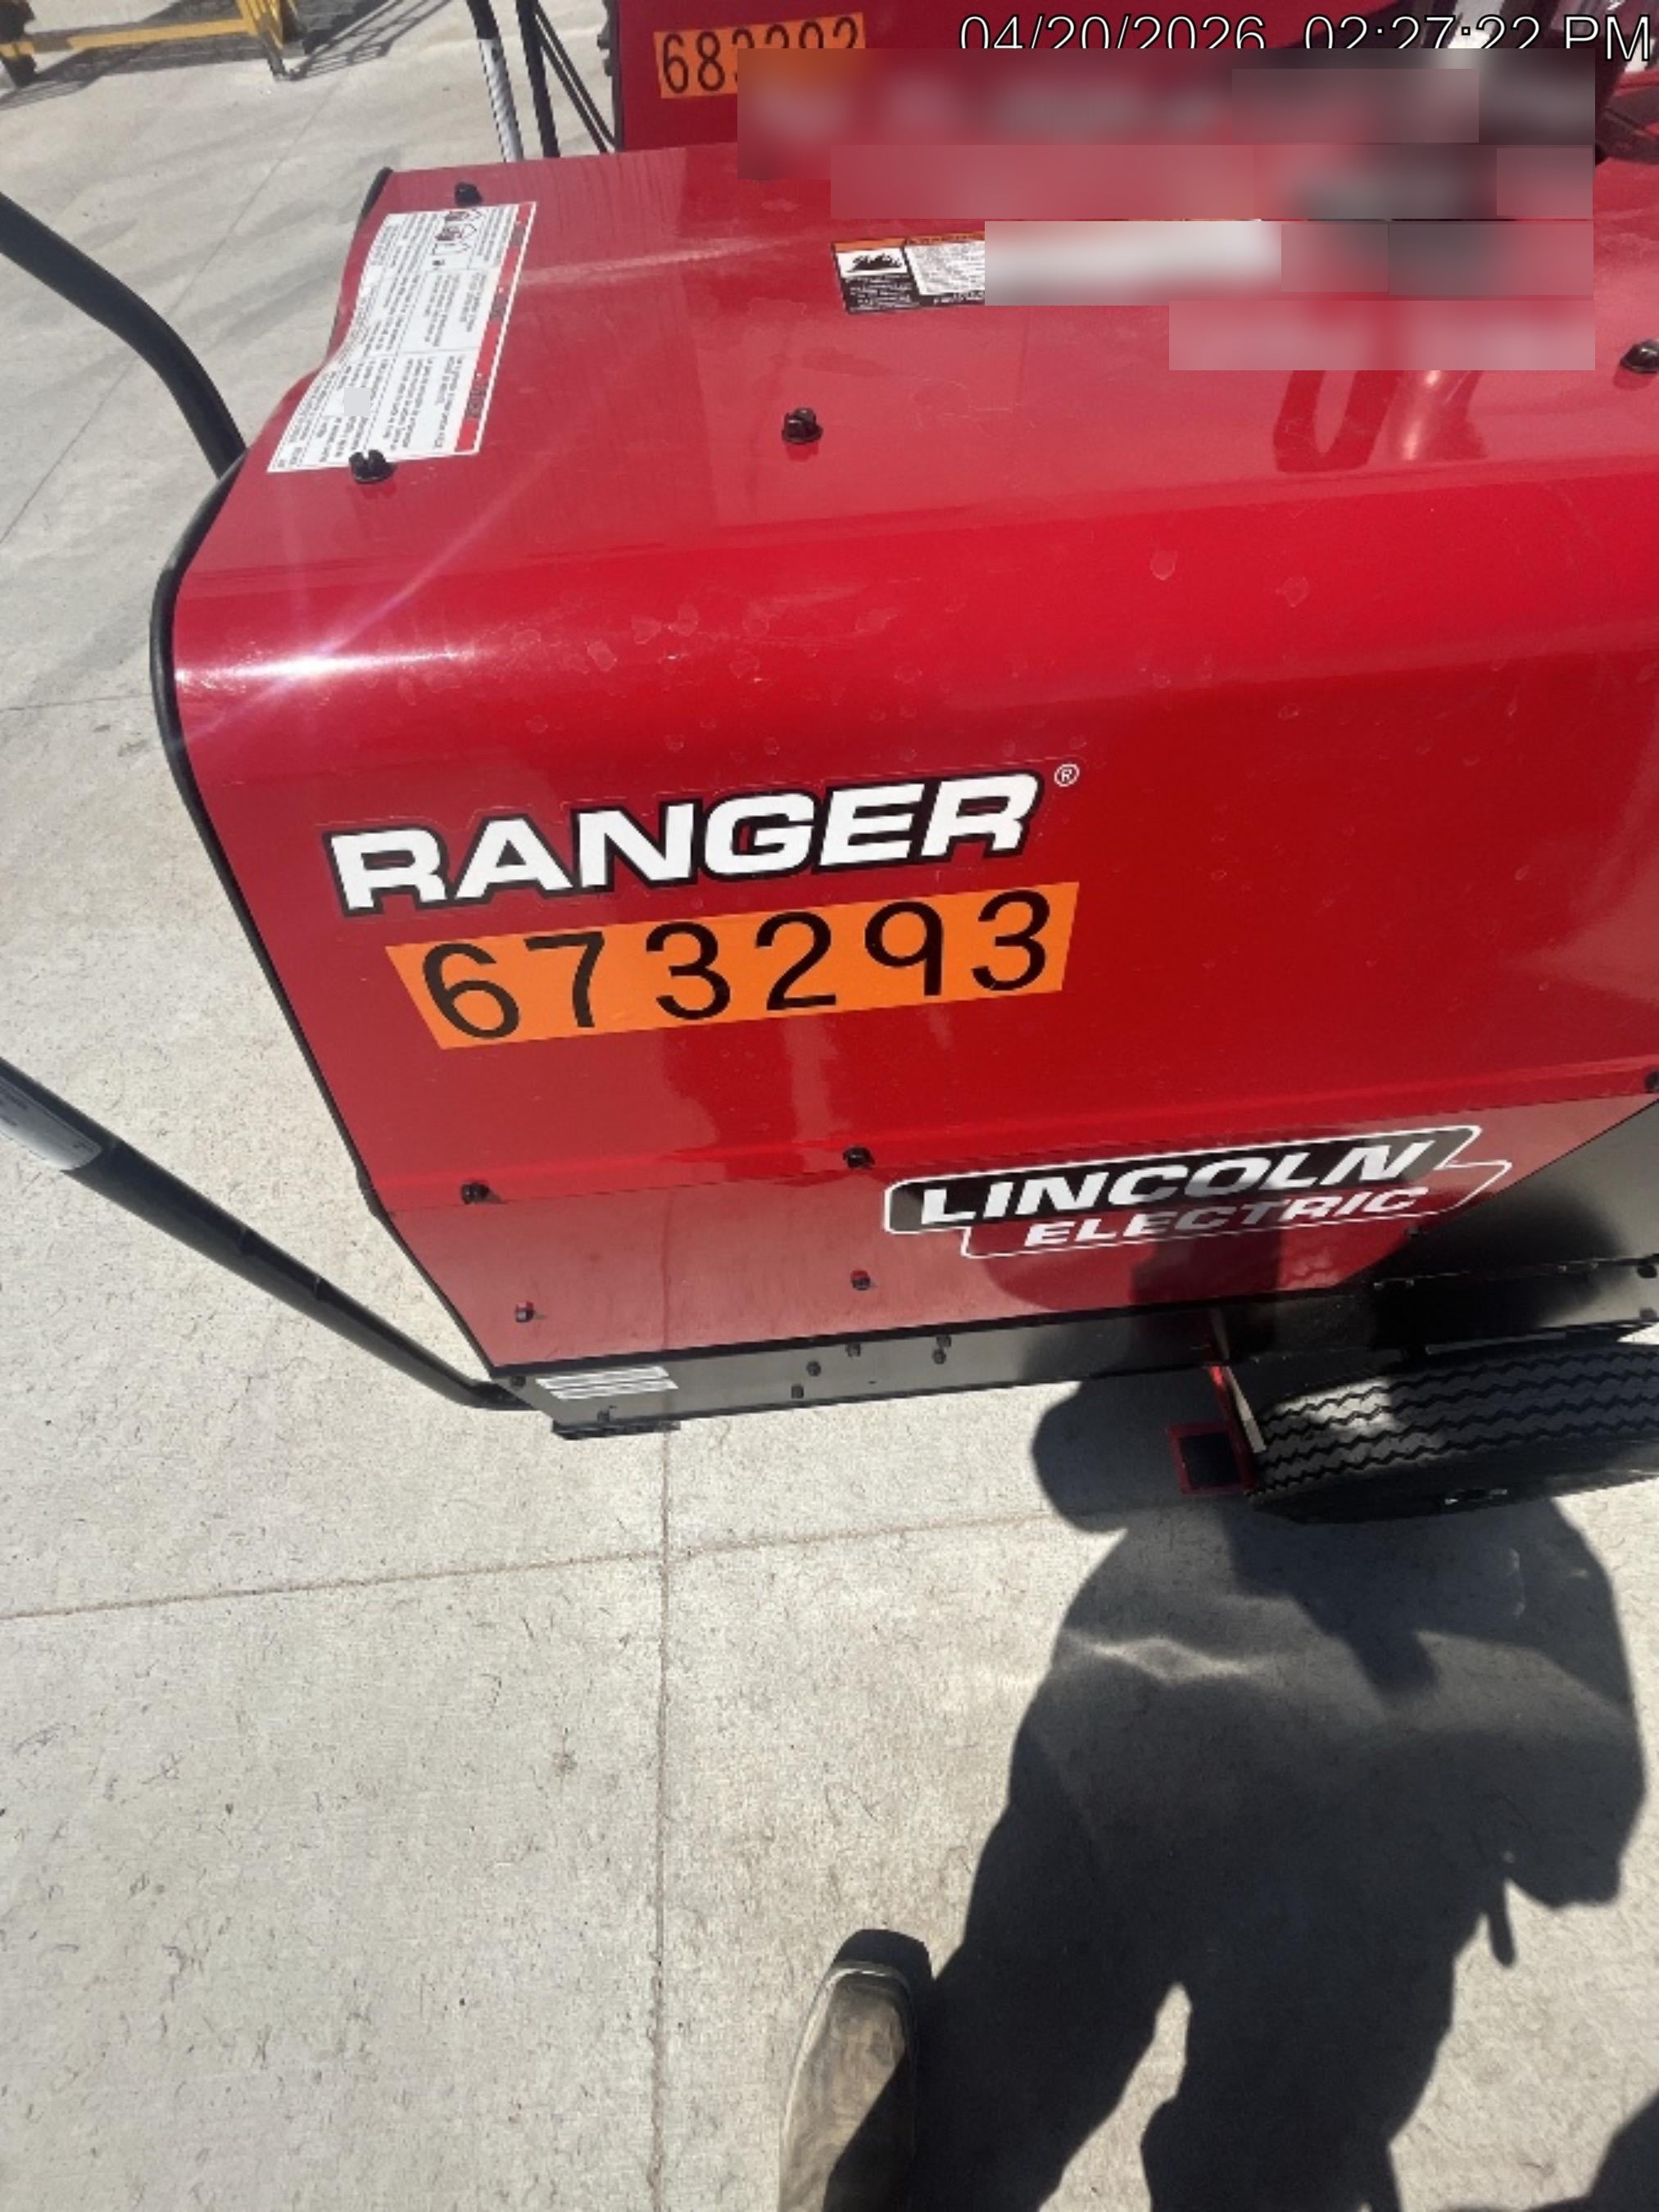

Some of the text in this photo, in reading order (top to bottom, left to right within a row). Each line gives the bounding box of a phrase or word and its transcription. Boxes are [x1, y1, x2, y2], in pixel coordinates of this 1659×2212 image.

[328, 773, 1040, 911] RANGER
[422, 889, 1052, 1039] 673293
[919, 1139, 1437, 1226] LINCOLN
[1022, 1185, 1430, 1247] ELECTRIC
